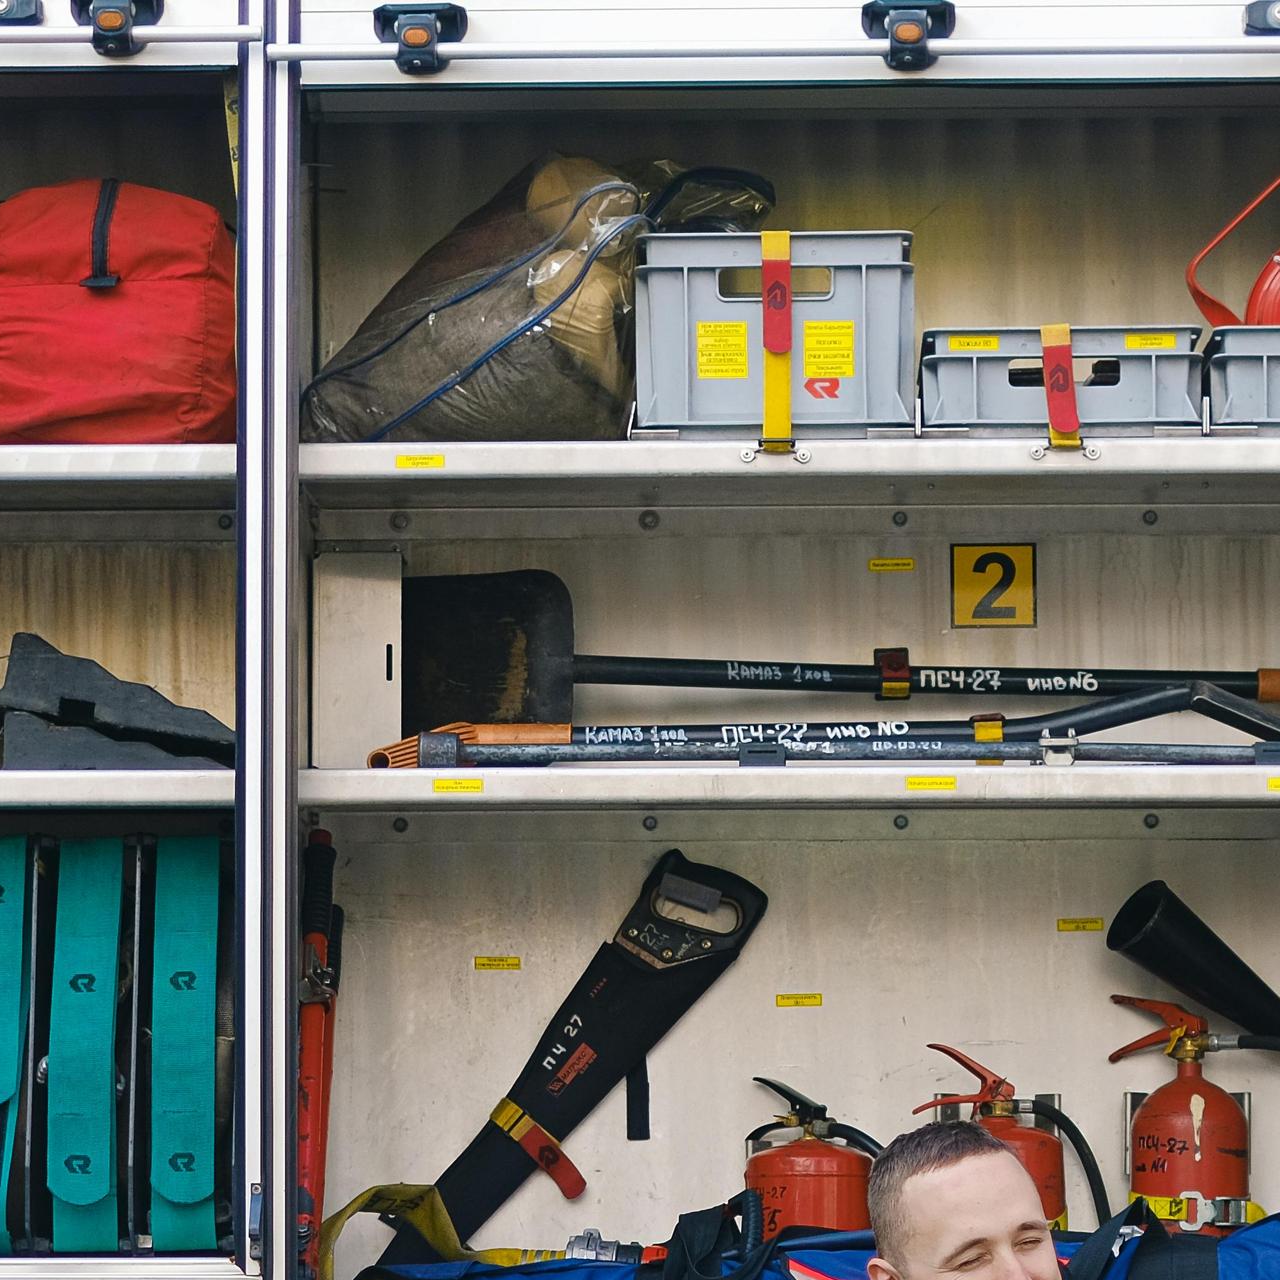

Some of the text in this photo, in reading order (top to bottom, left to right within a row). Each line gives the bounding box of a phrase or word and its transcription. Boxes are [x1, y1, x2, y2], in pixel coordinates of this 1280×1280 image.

[971, 552, 1017, 619] 2
[727, 662, 782, 681] КАМАЗ
[920, 669, 1002, 692] ПСЧ-27
[585, 725, 644, 744] КАМАЗ
[564, 1014, 582, 1037] 27
